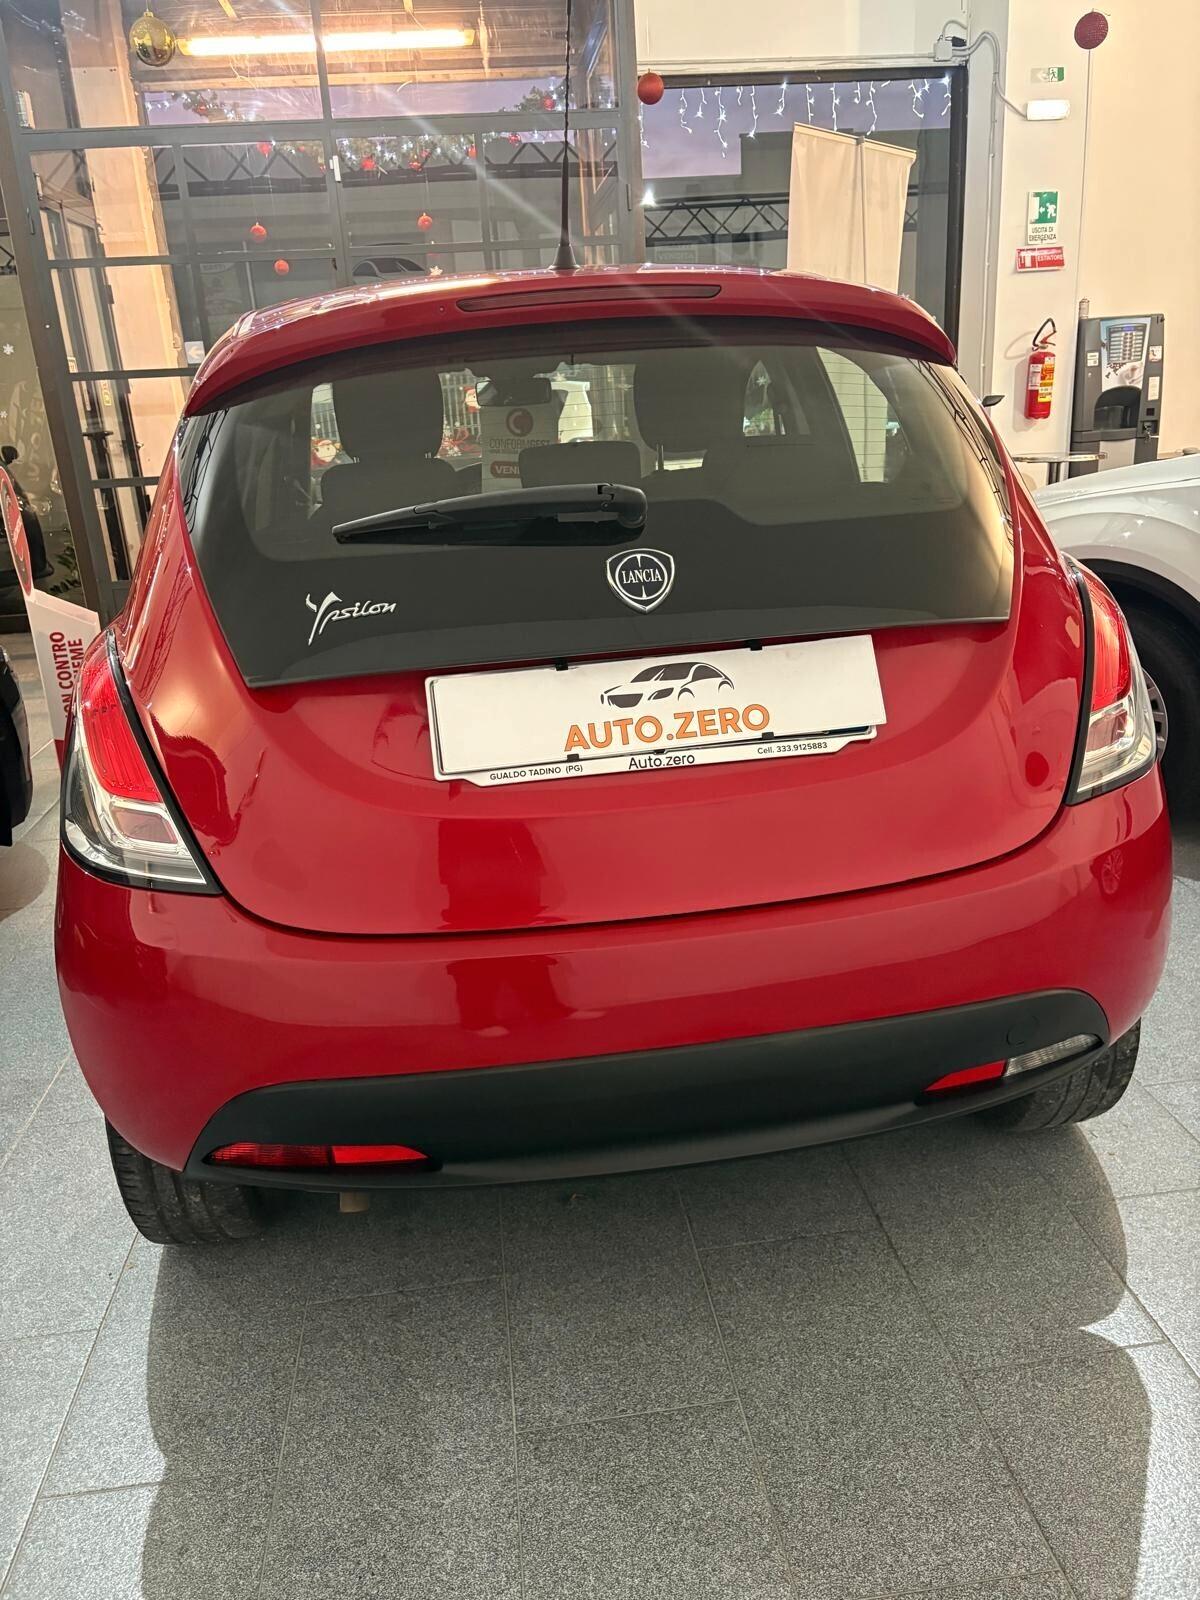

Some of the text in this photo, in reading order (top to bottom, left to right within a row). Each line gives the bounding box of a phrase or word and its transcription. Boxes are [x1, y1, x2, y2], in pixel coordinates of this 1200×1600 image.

[1032, 226, 1047, 234] USCITA
[1037, 254, 1064, 262] ESTINTORE
[621, 568, 663, 584] LANCIA
[305, 591, 397, 646] Ypsilon
[49, 631, 74, 690] CONTRO
[564, 703, 770, 752] AUTO.ZERO
[757, 741, 828, 755] Cell. 333.9125883
[628, 753, 695, 770] Auto.zero
[489, 764, 583, 780] GUALDO TADINO (PG)
